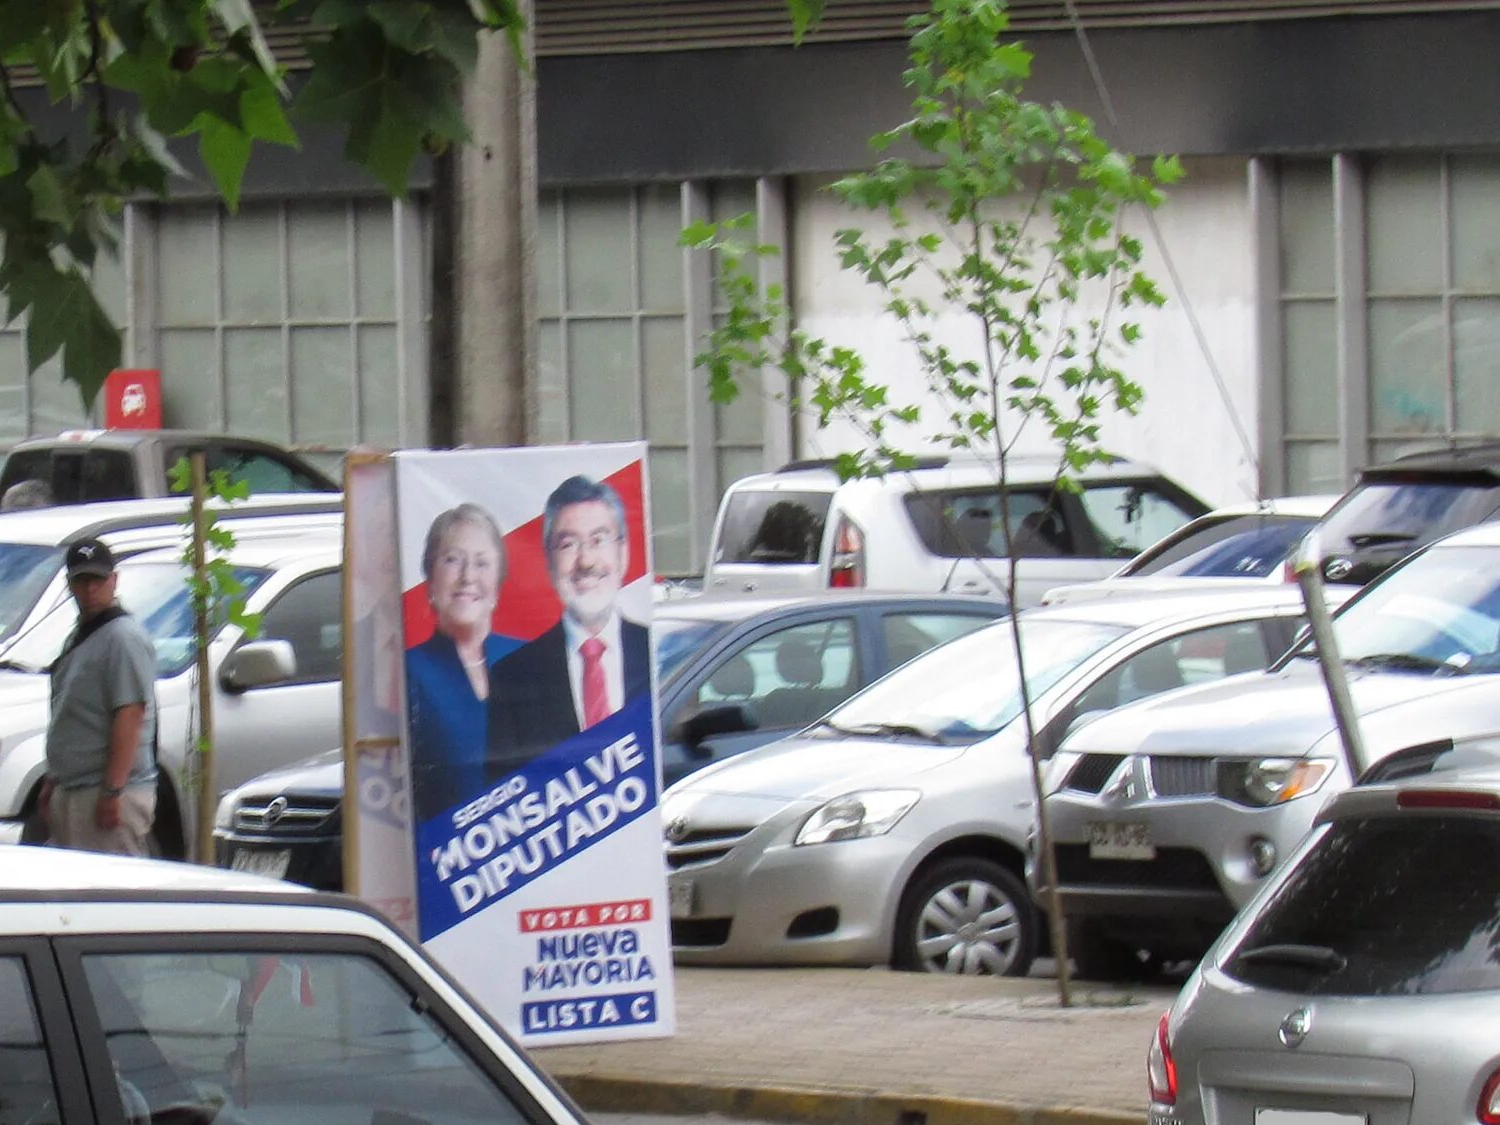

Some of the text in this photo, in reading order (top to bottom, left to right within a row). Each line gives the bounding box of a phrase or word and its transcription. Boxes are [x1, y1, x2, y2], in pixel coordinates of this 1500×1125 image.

[431, 732, 646, 881] MONSALVE
[452, 775, 527, 829] SERGIO
[450, 776, 647, 913] DIPUTADO
[525, 904, 645, 930] VOTA POR
[538, 929, 638, 962] Nueva
[524, 955, 655, 992] MAYORIA
[528, 996, 650, 1030] LISTA C
